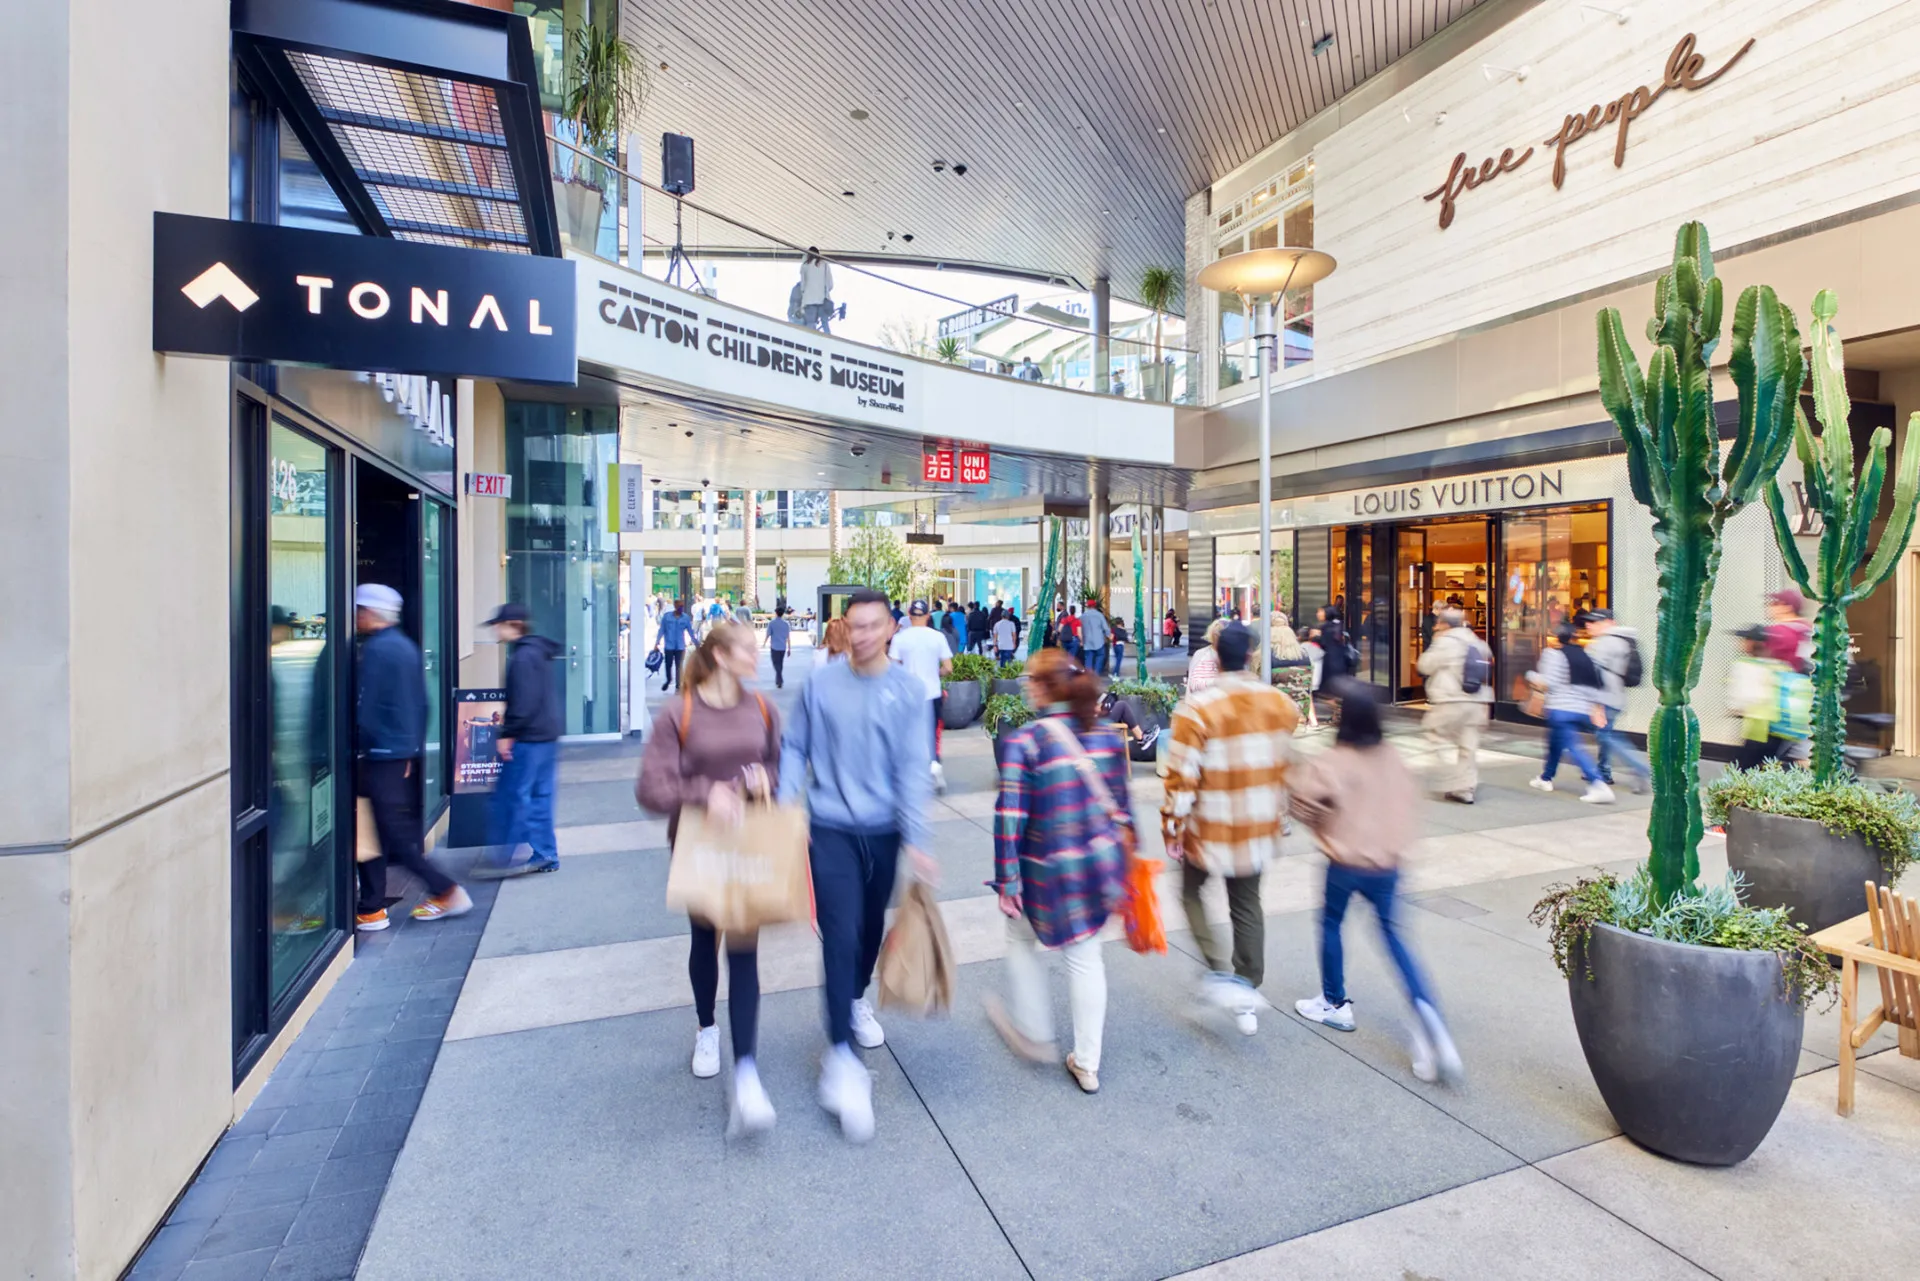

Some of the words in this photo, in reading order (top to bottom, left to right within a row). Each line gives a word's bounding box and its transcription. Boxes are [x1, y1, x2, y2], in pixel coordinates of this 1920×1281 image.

[1424, 147, 1534, 229] free
[1543, 32, 1756, 190] people
[296, 275, 552, 336] TONAL
[599, 299, 699, 350] CAYTON
[830, 365, 904, 399] MUSEUM
[857, 395, 868, 408] by
[271, 456, 297, 502] 126
[476, 474, 506, 496] EXIT
[627, 478, 636, 510] ELEVATOR
[1354, 487, 1421, 516] LOUIS
[1431, 469, 1562, 508] VUITTON
